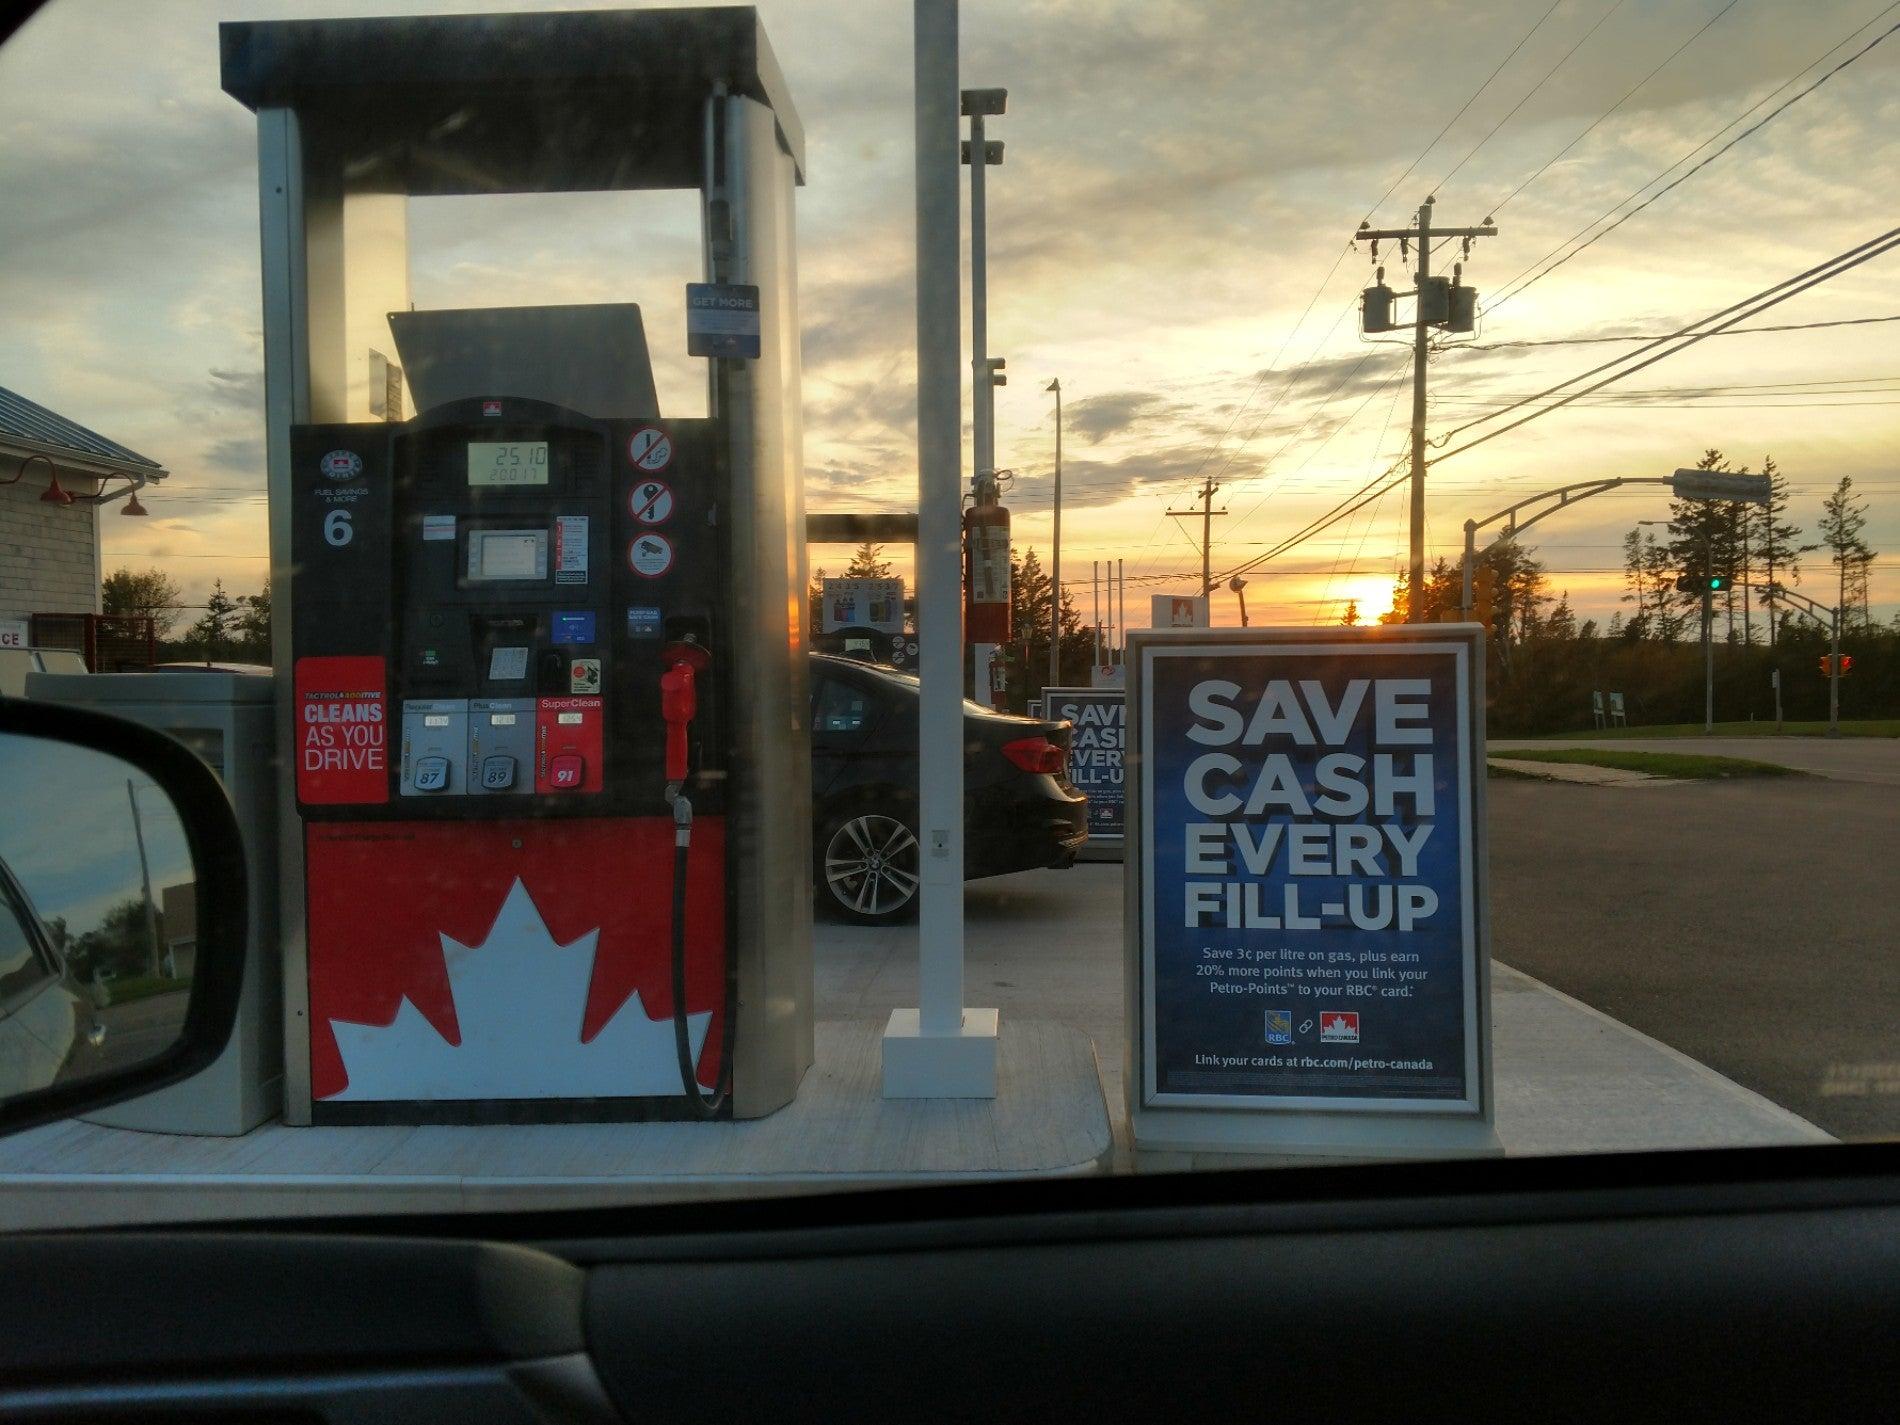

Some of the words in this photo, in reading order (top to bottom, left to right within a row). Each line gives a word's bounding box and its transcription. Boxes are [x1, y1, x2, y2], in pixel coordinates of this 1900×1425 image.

[693, 297, 714, 306] GET
[719, 297, 753, 308] MORE
[335, 488, 369, 496] SAVINGS
[324, 509, 353, 546] 6
[304, 703, 383, 723] CLEANS
[1185, 679, 1434, 746] SAVE
[305, 725, 335, 746] AS
[341, 725, 383, 746] YOU
[305, 748, 384, 771] DRIVE
[420, 772, 439, 784] 87
[488, 771, 506, 783] 89
[558, 770, 573, 782] 91
[1184, 753, 1435, 816] CASH
[1184, 823, 1435, 876] EVERY
[1184, 882, 1439, 931] FILL-UP
[1203, 948, 1233, 959] Save
[1256, 950, 1277, 962] per
[1280, 948, 1305, 960] litre
[1309, 951, 1325, 961] on
[1328, 952, 1356, 963] gas,
[1359, 950, 1387, 963] plus
[1390, 953, 1420, 962] earn
[1196, 965, 1224, 976] 20%
[1228, 967, 1260, 977] more
[1264, 966, 1304, 979] points
[1307, 967, 1341, 978] when
[1345, 969, 1369, 981] you
[1372, 967, 1396, 979] link
[1399, 970, 1428, 982] your
[1298, 984, 1311, 995] to
[1314, 986, 1343, 998] your
[1268, 1034, 1290, 1042] RBC
[1195, 1055, 1220, 1065] Link
[1221, 1057, 1249, 1068] your
[1251, 1055, 1283, 1067] cards
[1286, 1058, 1298, 1067] at
[1301, 1056, 1434, 1071] rbc.com/petro-canada
